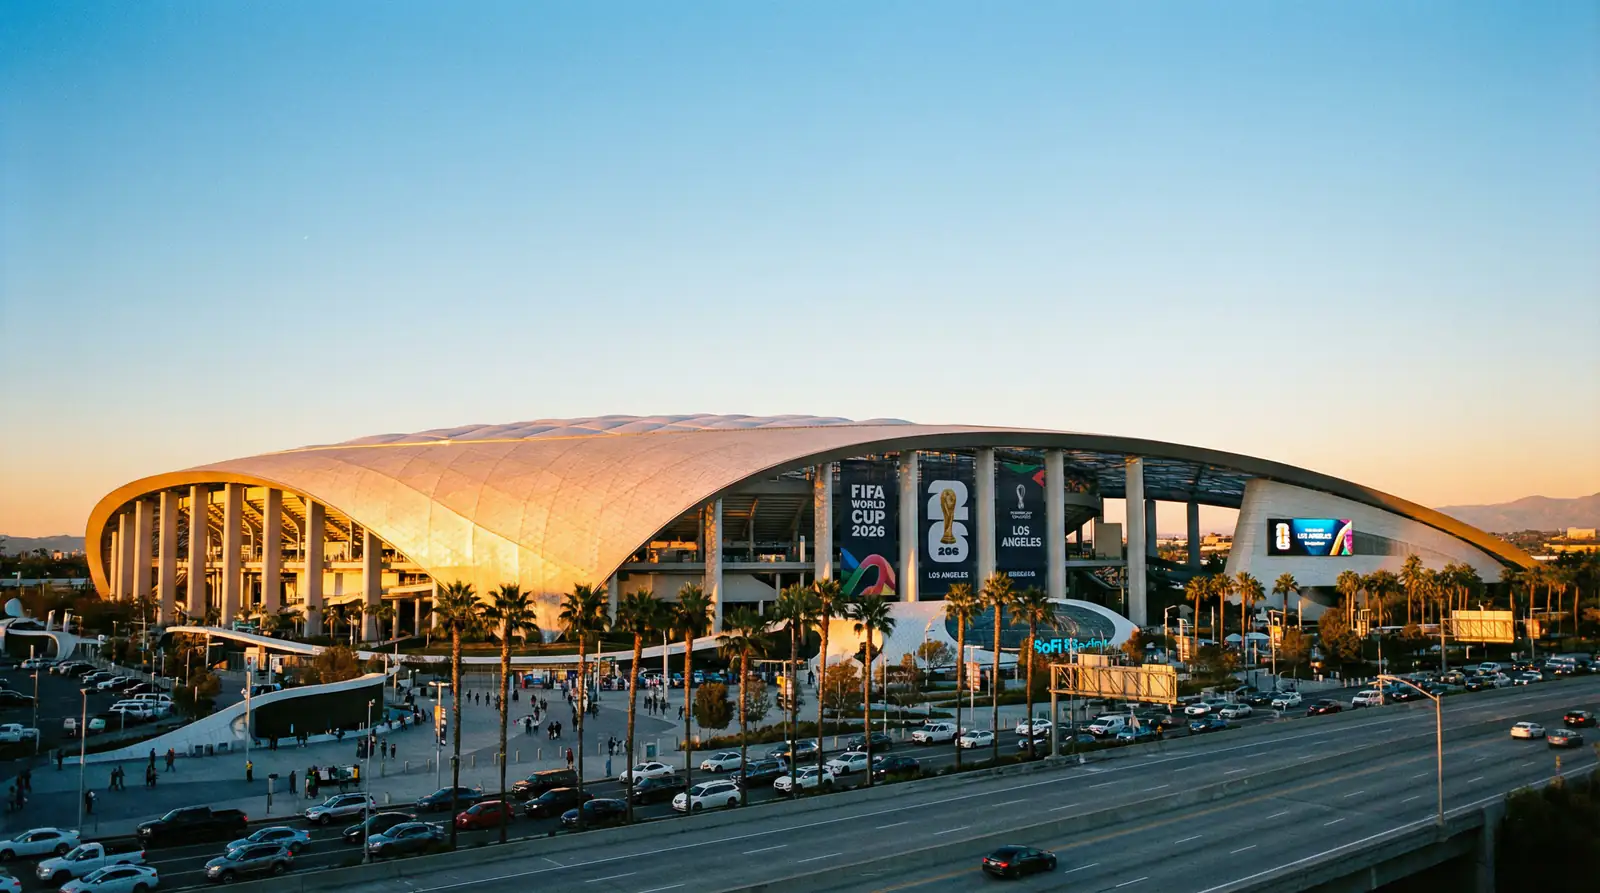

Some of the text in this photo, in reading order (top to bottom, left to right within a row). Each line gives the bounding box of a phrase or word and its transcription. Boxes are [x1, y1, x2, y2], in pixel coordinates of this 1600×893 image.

[851, 484, 885, 499] FIFA
[851, 500, 885, 509] WORLD
[851, 510, 885, 524] CUP
[851, 525, 885, 537] 2026
[1012, 525, 1030, 536] LOS
[1001, 537, 1042, 547] ANGELES
[938, 547, 959, 556] 206
[928, 571, 969, 579] LOS ANGELES
[1033, 638, 1062, 654] SoFi
